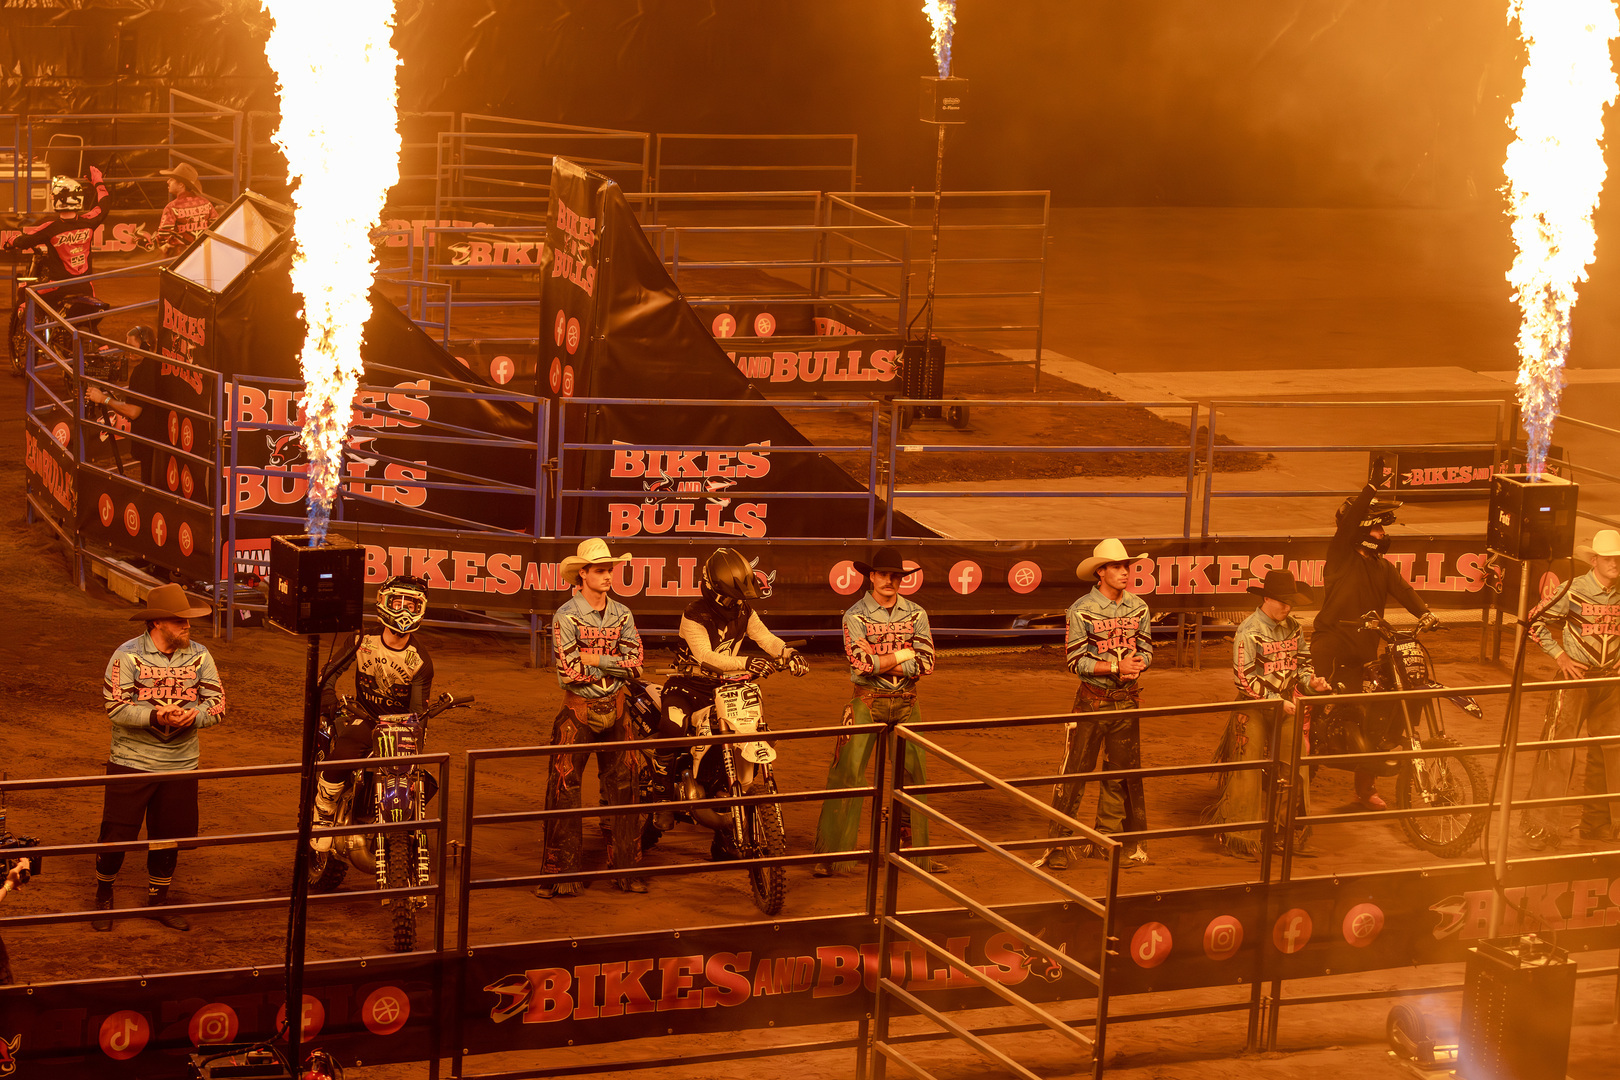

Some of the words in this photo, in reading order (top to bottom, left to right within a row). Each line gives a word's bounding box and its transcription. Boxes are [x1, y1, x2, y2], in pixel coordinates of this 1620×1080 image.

[557, 198, 596, 247] BIKES
[552, 248, 596, 297] BULLS
[163, 298, 206, 346] BIKES
[770, 350, 897, 382] BULLS
[610, 440, 771, 478] BIKES
[1410, 466, 1473, 486] BIKES
[607, 503, 767, 538] BULLS
[364, 545, 522, 595] BIKES
[865, 621, 914, 636] BIKES
[1091, 616, 1140, 633] BIKES
[1096, 637, 1137, 654] BULLS
[138, 664, 198, 680] BIKES
[361, 659, 373, 672] SEE
[374, 656, 388, 665] NO
[137, 686, 198, 702] BULLS
[522, 951, 752, 1024] BIKES
[753, 956, 815, 996] AND
[812, 930, 1030, 999] BULLS
